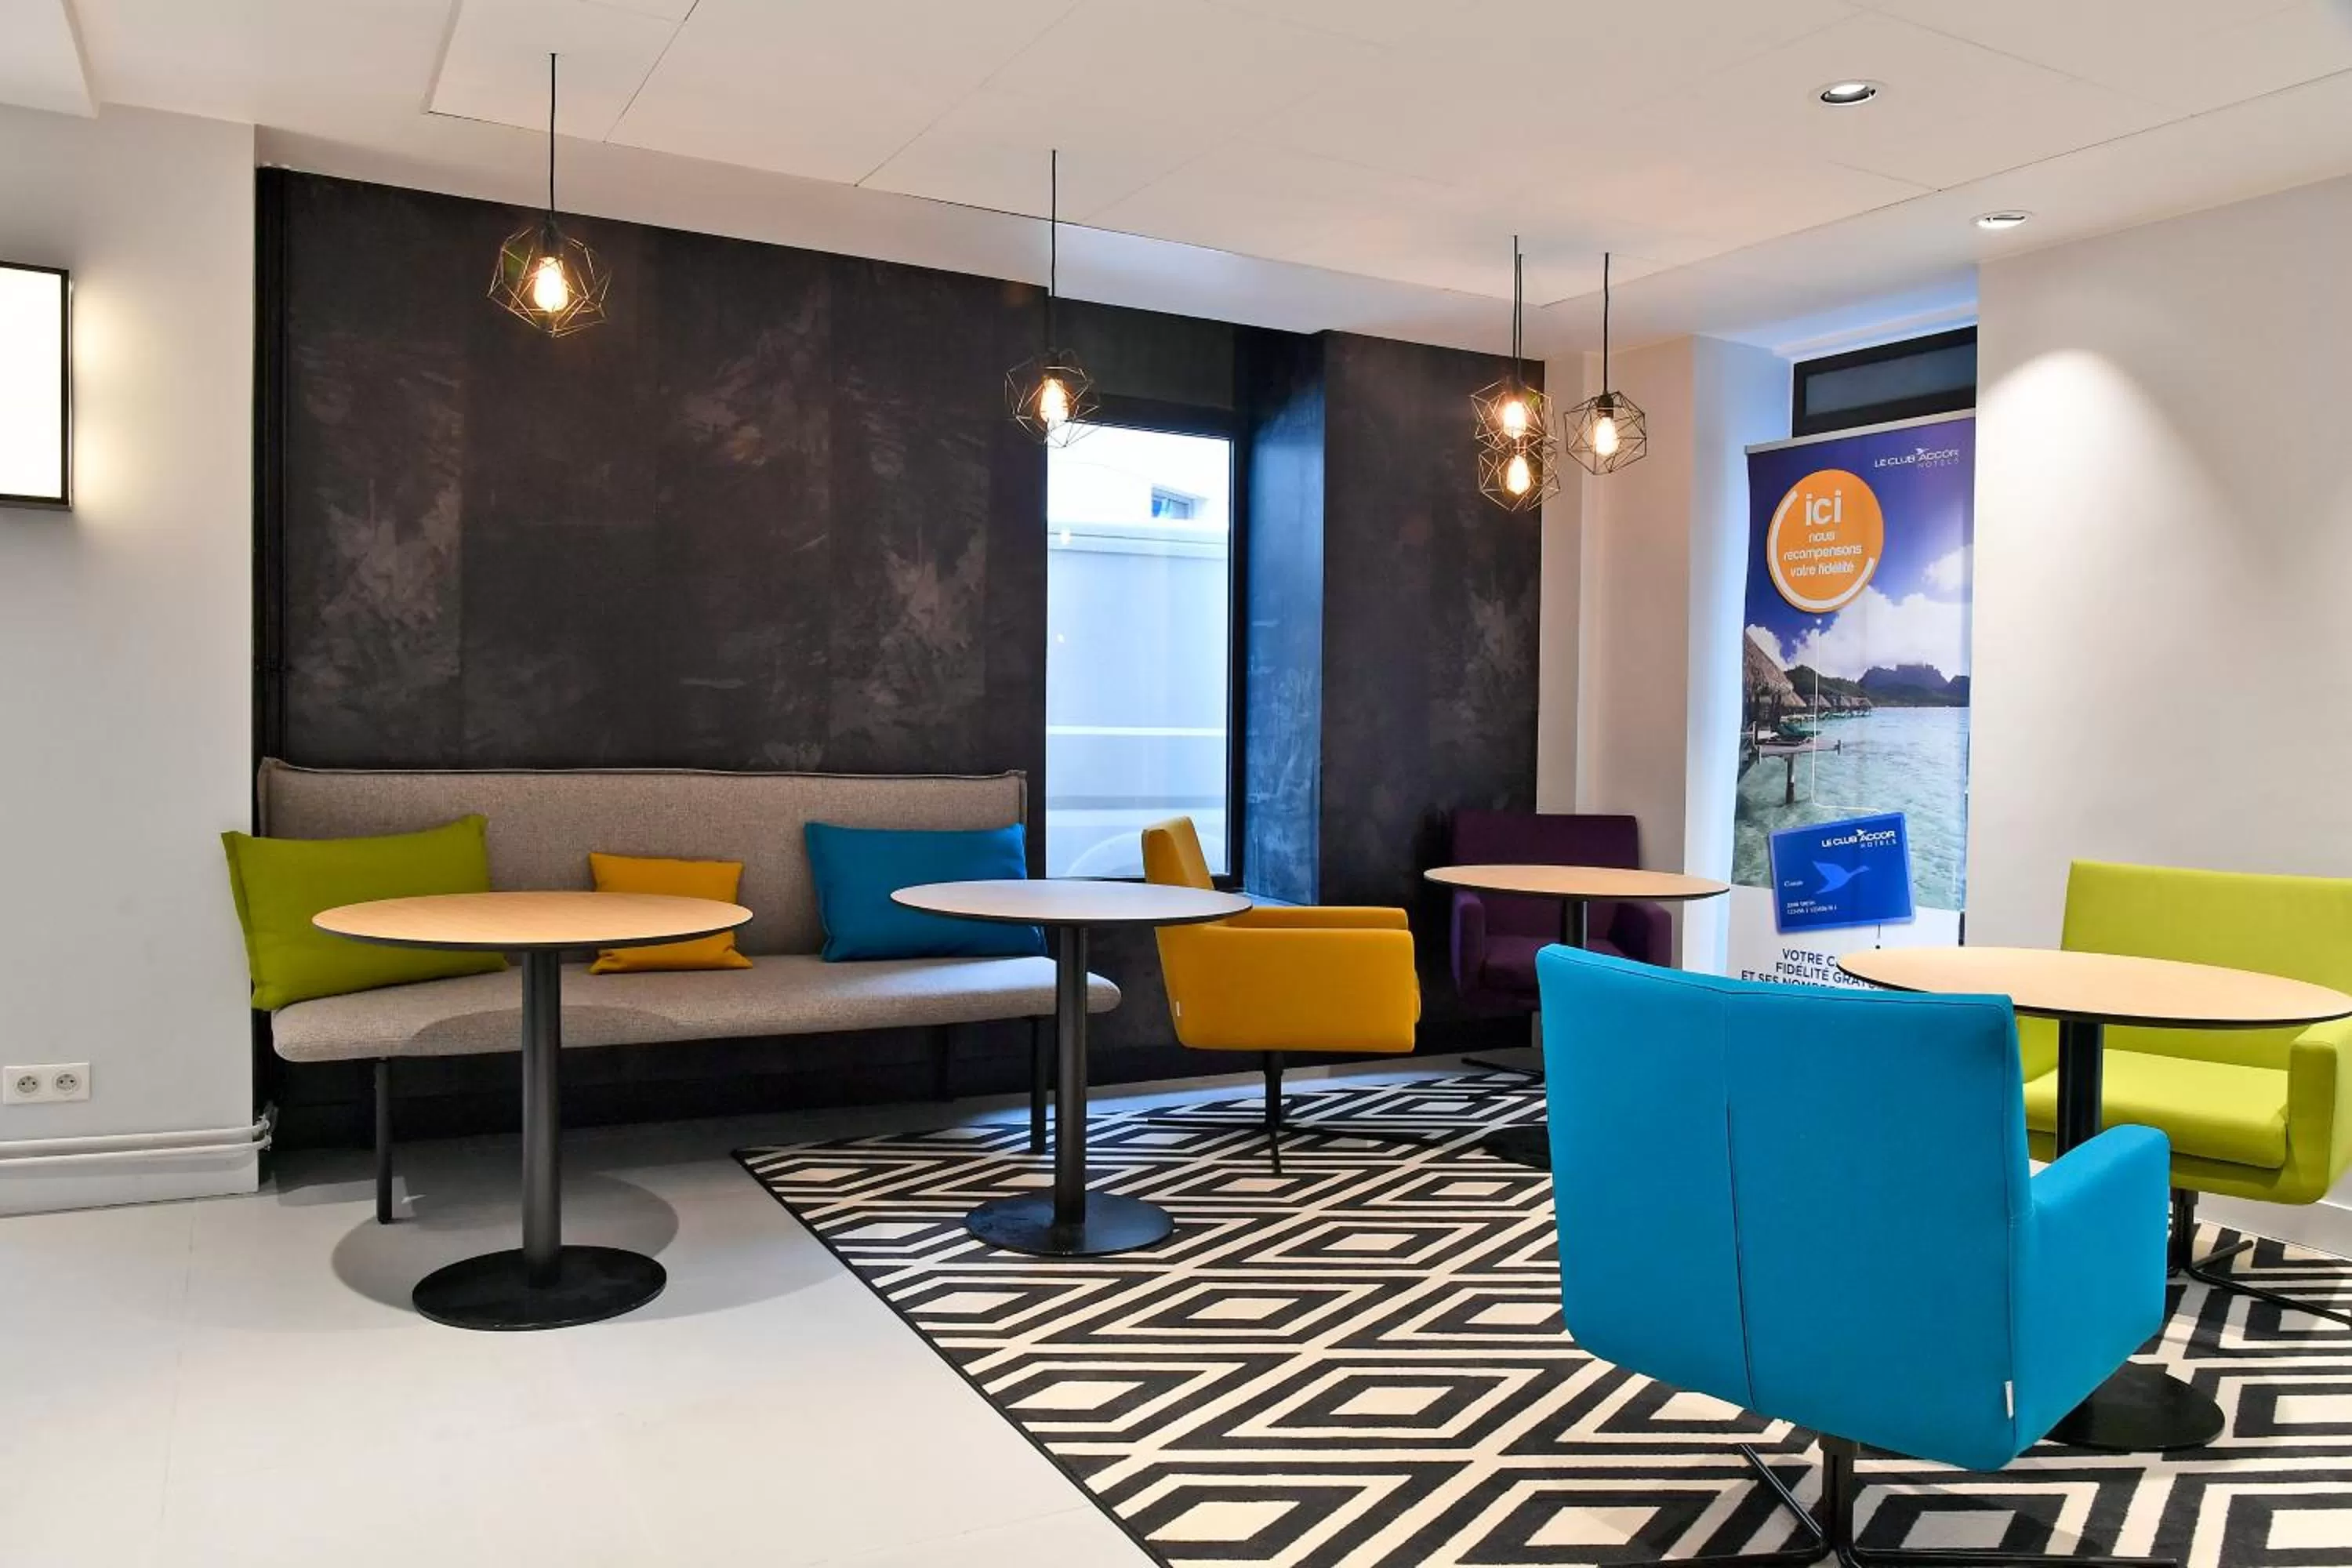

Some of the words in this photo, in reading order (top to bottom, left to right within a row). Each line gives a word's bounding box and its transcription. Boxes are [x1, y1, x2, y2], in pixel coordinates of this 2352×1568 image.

[1875, 459, 1887, 468] LE
[1888, 455, 1915, 465] CLUB
[1918, 449, 1959, 461] ACCOR
[1806, 489, 1842, 526] ici
[1809, 532, 1835, 543] nous
[1791, 564, 1816, 577] votre
[1833, 836, 1857, 846] CLUB
[1860, 831, 1896, 842] ACCOR
[1782, 949, 1823, 965] VOTRE
[1741, 969, 1755, 981] ET
